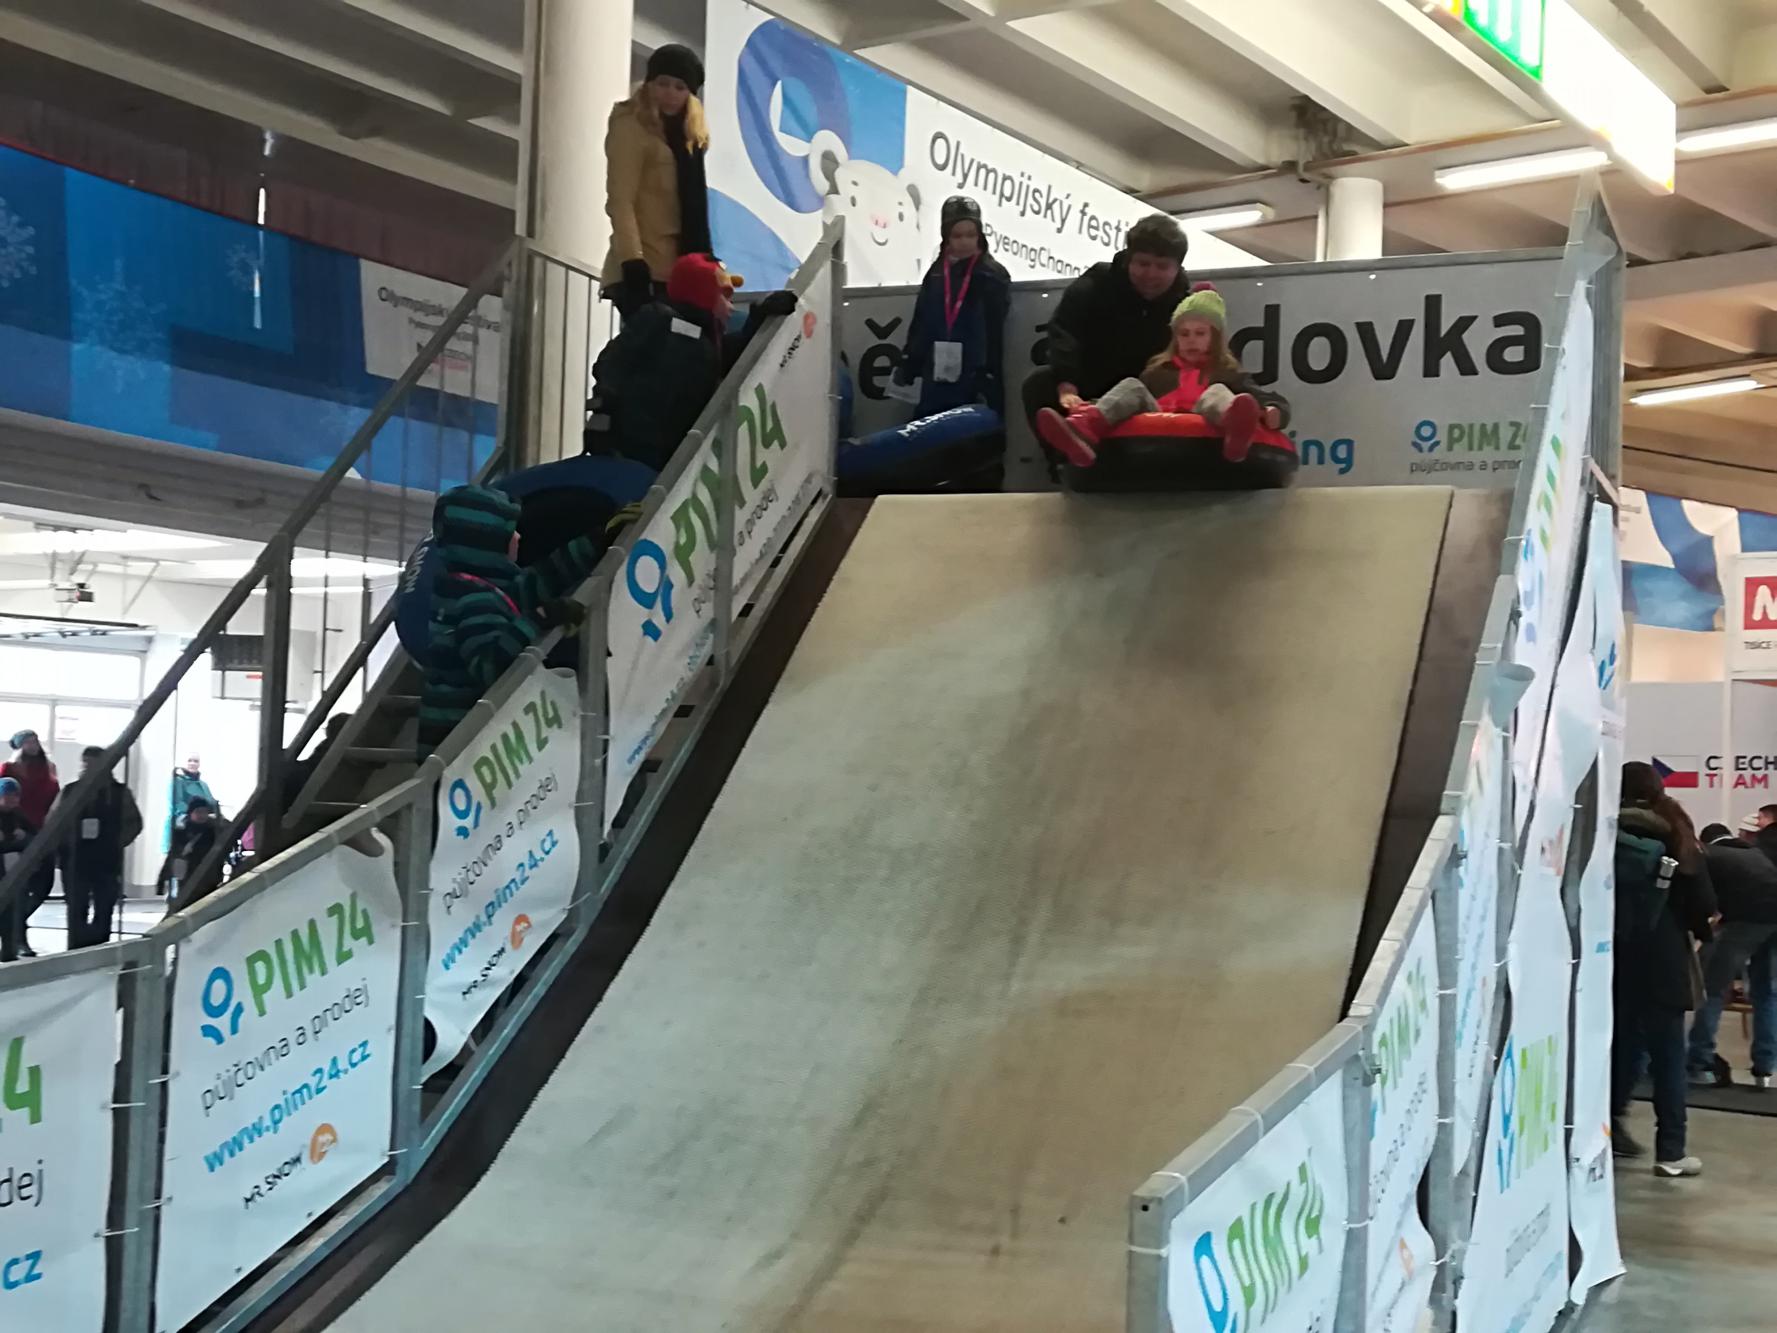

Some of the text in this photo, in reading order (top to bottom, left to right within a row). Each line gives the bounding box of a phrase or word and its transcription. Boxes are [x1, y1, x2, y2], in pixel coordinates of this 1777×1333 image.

[929, 131, 1072, 234] Olympijský
[737, 382, 788, 489] 24
[1447, 420, 1528, 452] PIM 2
[1479, 461, 1488, 471] a
[473, 689, 563, 810] PIM 24
[1705, 755, 1777, 771] CECH
[1705, 773, 1769, 789] TAM
[442, 767, 559, 916] půjčovna a prodej
[441, 829, 559, 971] www.pim24.cz
[245, 891, 376, 1017] PIM 24
[0, 1035, 42, 1130] 4
[201, 976, 370, 1117] půjčovna a prodej
[203, 1039, 372, 1173] www.pim24.cz
